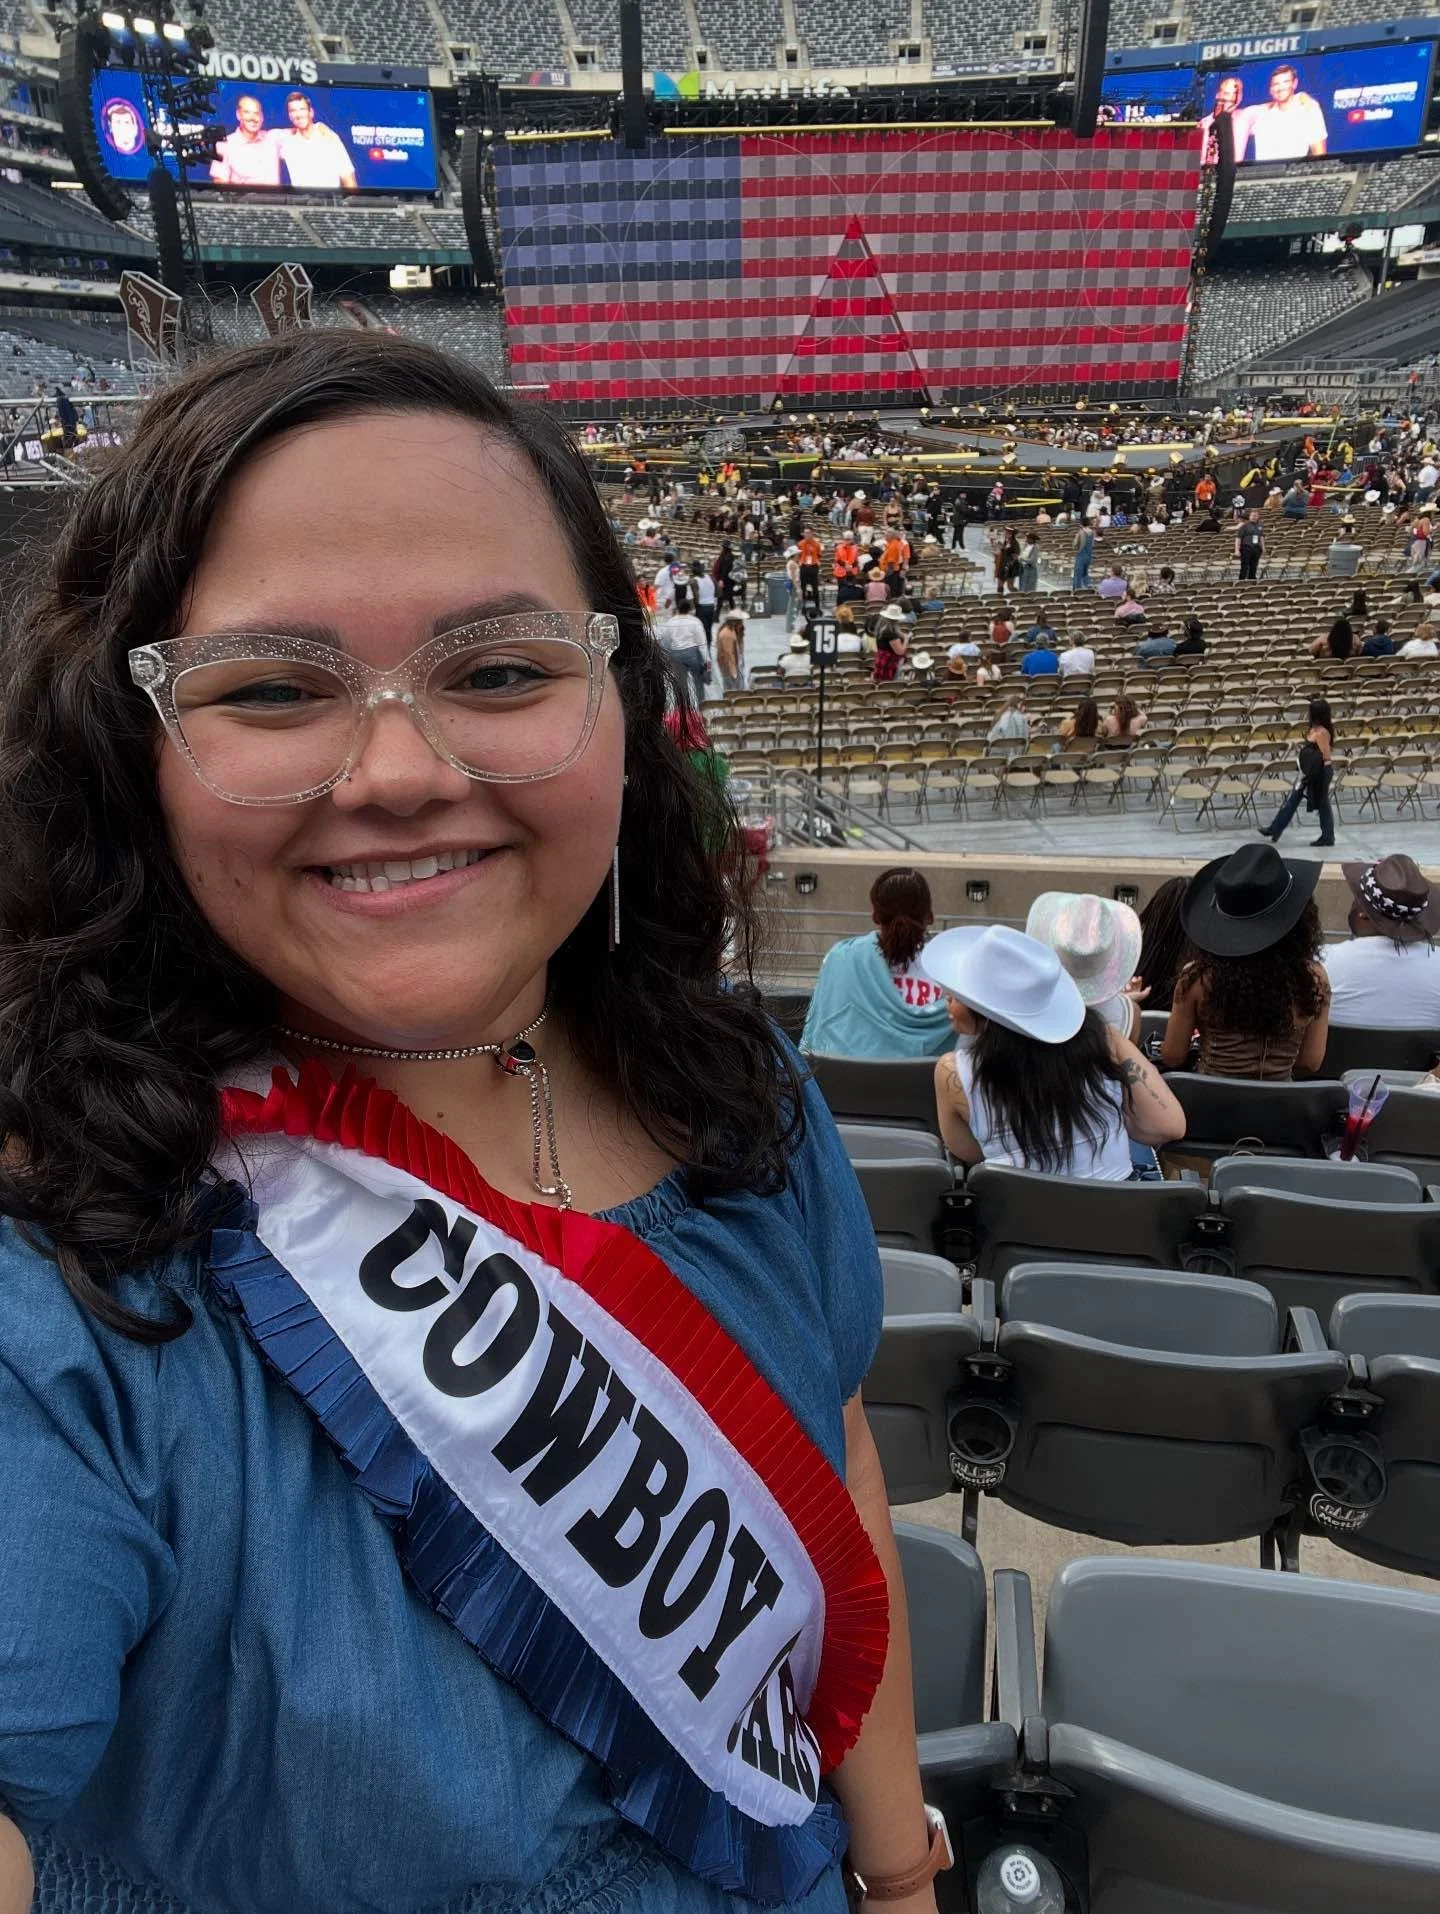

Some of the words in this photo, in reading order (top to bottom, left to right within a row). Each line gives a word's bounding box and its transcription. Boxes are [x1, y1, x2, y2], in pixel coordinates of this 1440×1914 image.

[1202, 43, 1242, 60] BUD
[1243, 36, 1301, 55] LIGHT
[198, 52, 319, 84] MOODY'S
[813, 625, 836, 653] 15
[358, 1198, 784, 1702] COWBOY
